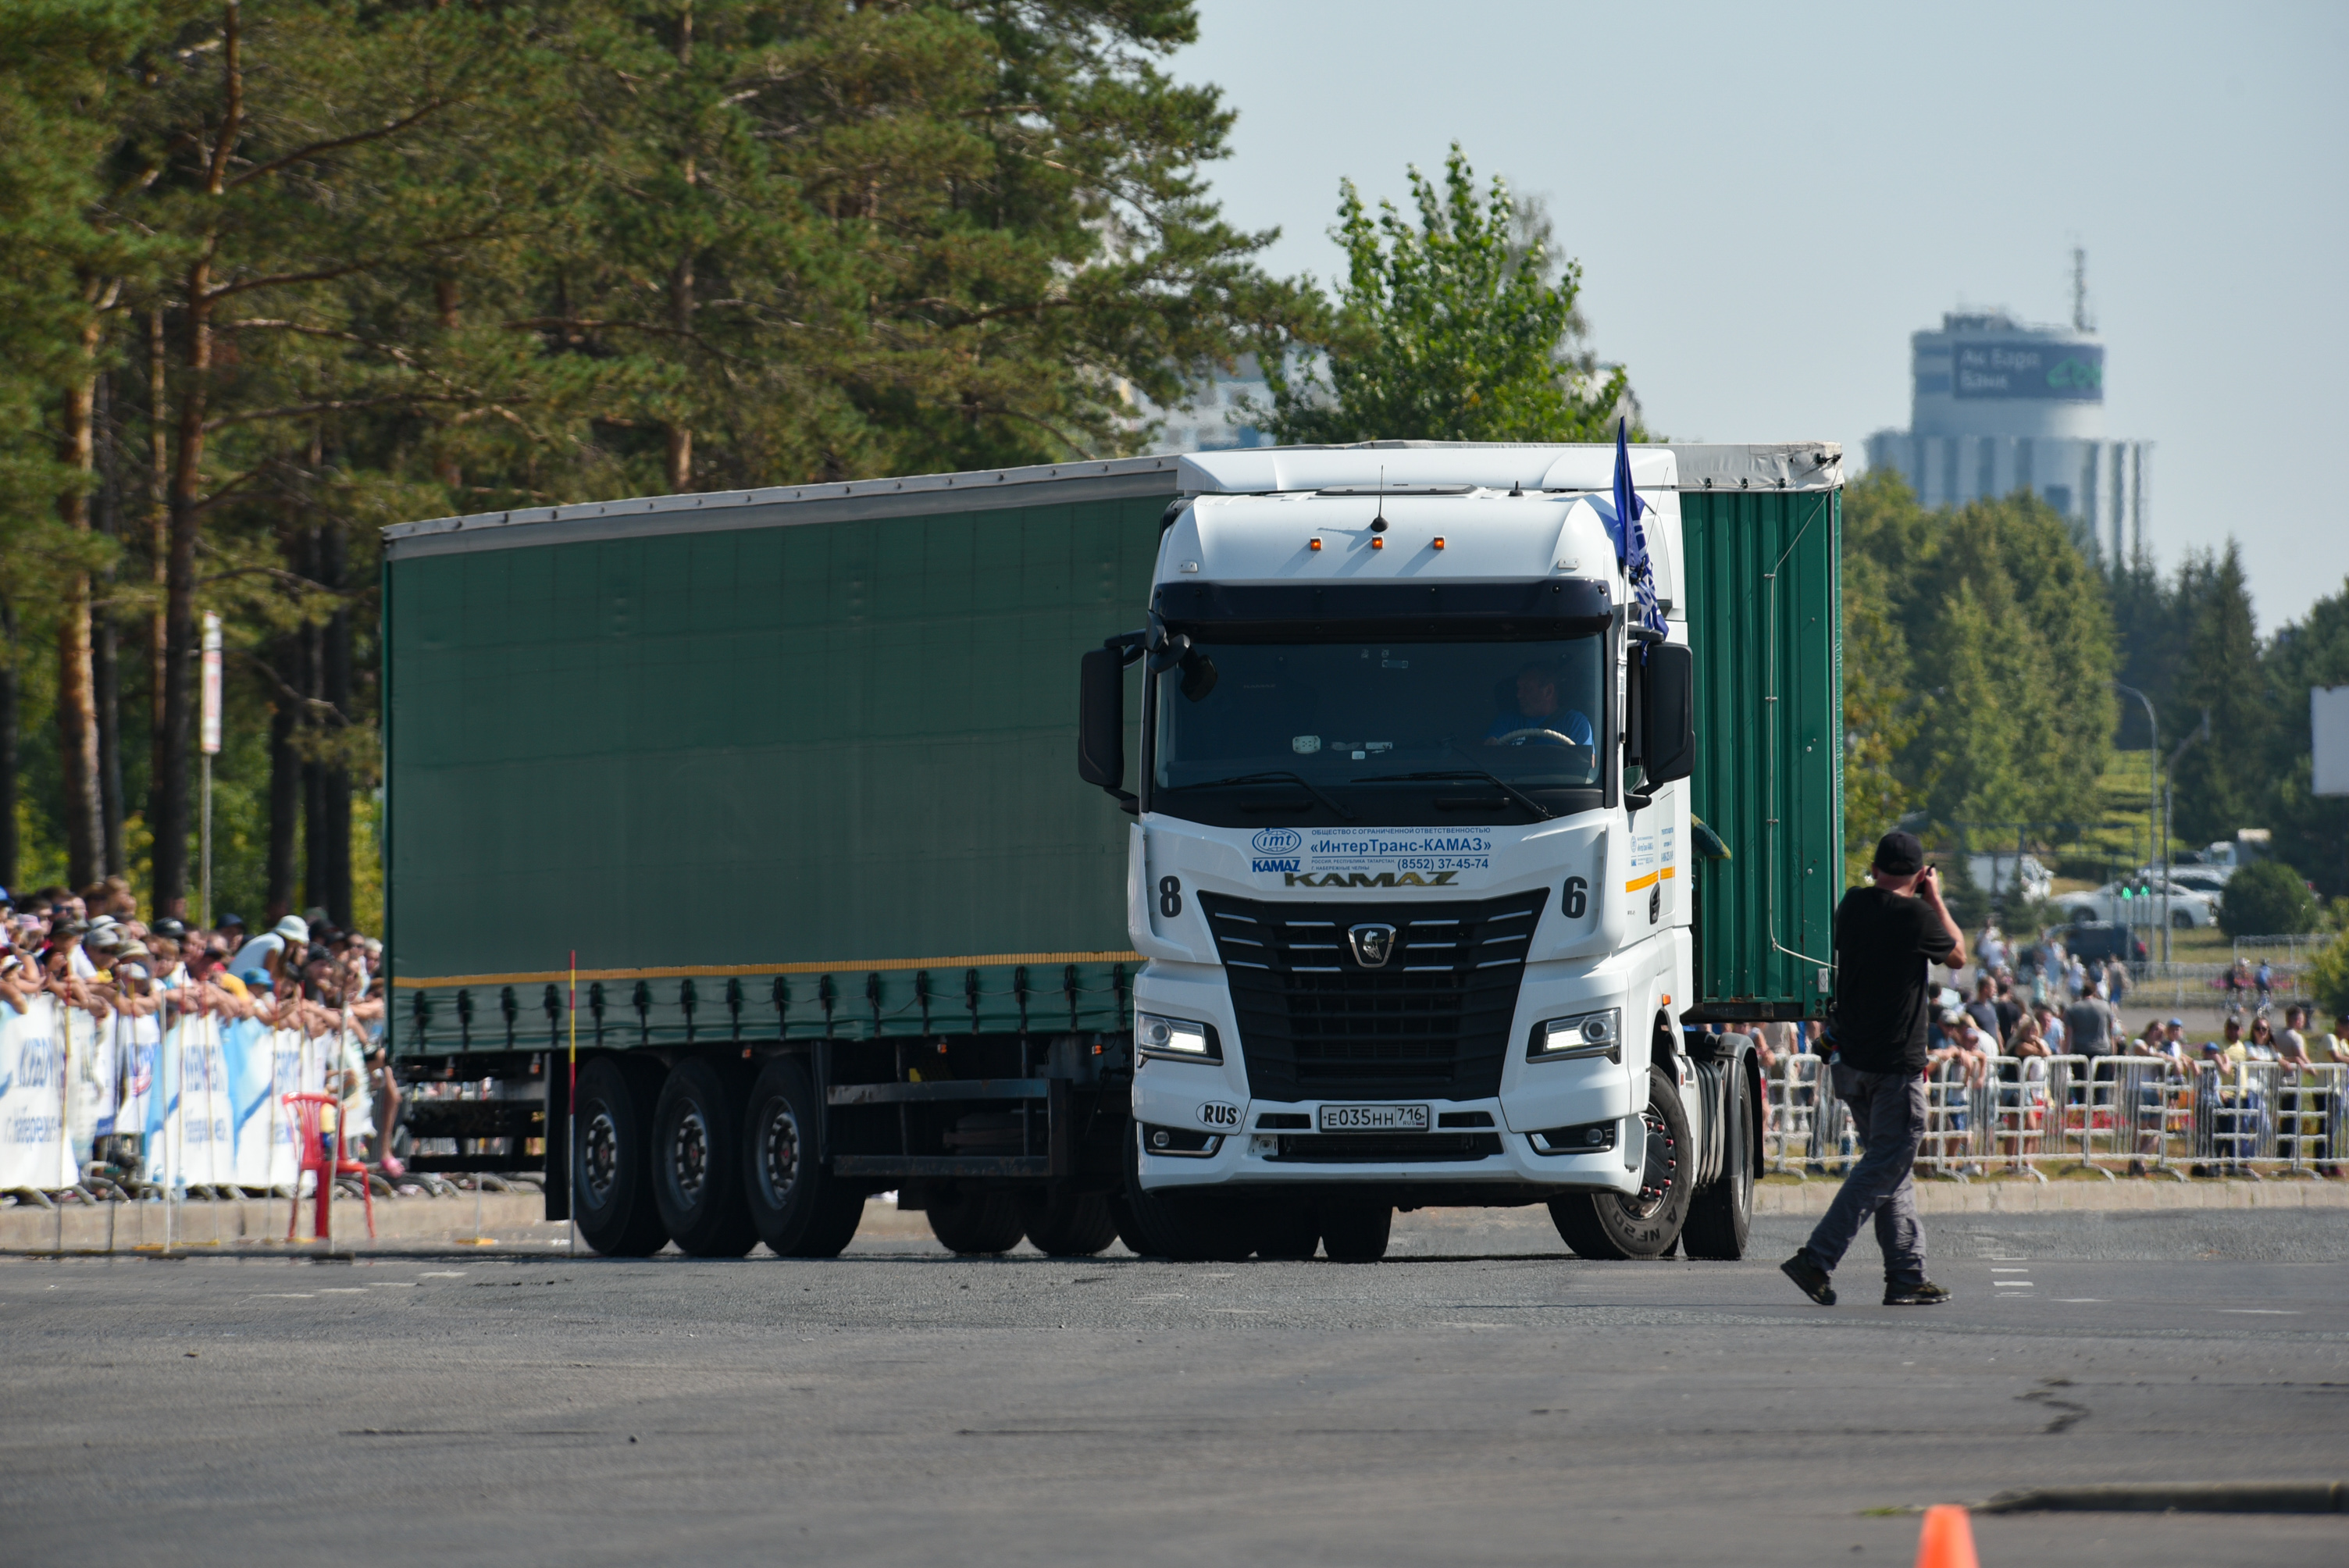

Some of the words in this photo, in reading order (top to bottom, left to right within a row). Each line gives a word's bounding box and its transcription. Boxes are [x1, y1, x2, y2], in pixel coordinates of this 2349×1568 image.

[1310, 837, 1491, 855] «ИнтерТранс-КАМАЗ»
[1253, 859, 1301, 872] KAMAZ
[1398, 858, 1434, 871] (8552)
[1438, 858, 1488, 869] 37-45-74
[1285, 871, 1459, 887] KAMAZ
[1159, 875, 1182, 918] 8
[1562, 876, 1587, 918] 6
[1204, 1104, 1237, 1124] RUS
[1328, 1109, 1394, 1126] Е035НН
[1397, 1107, 1422, 1121] 716
